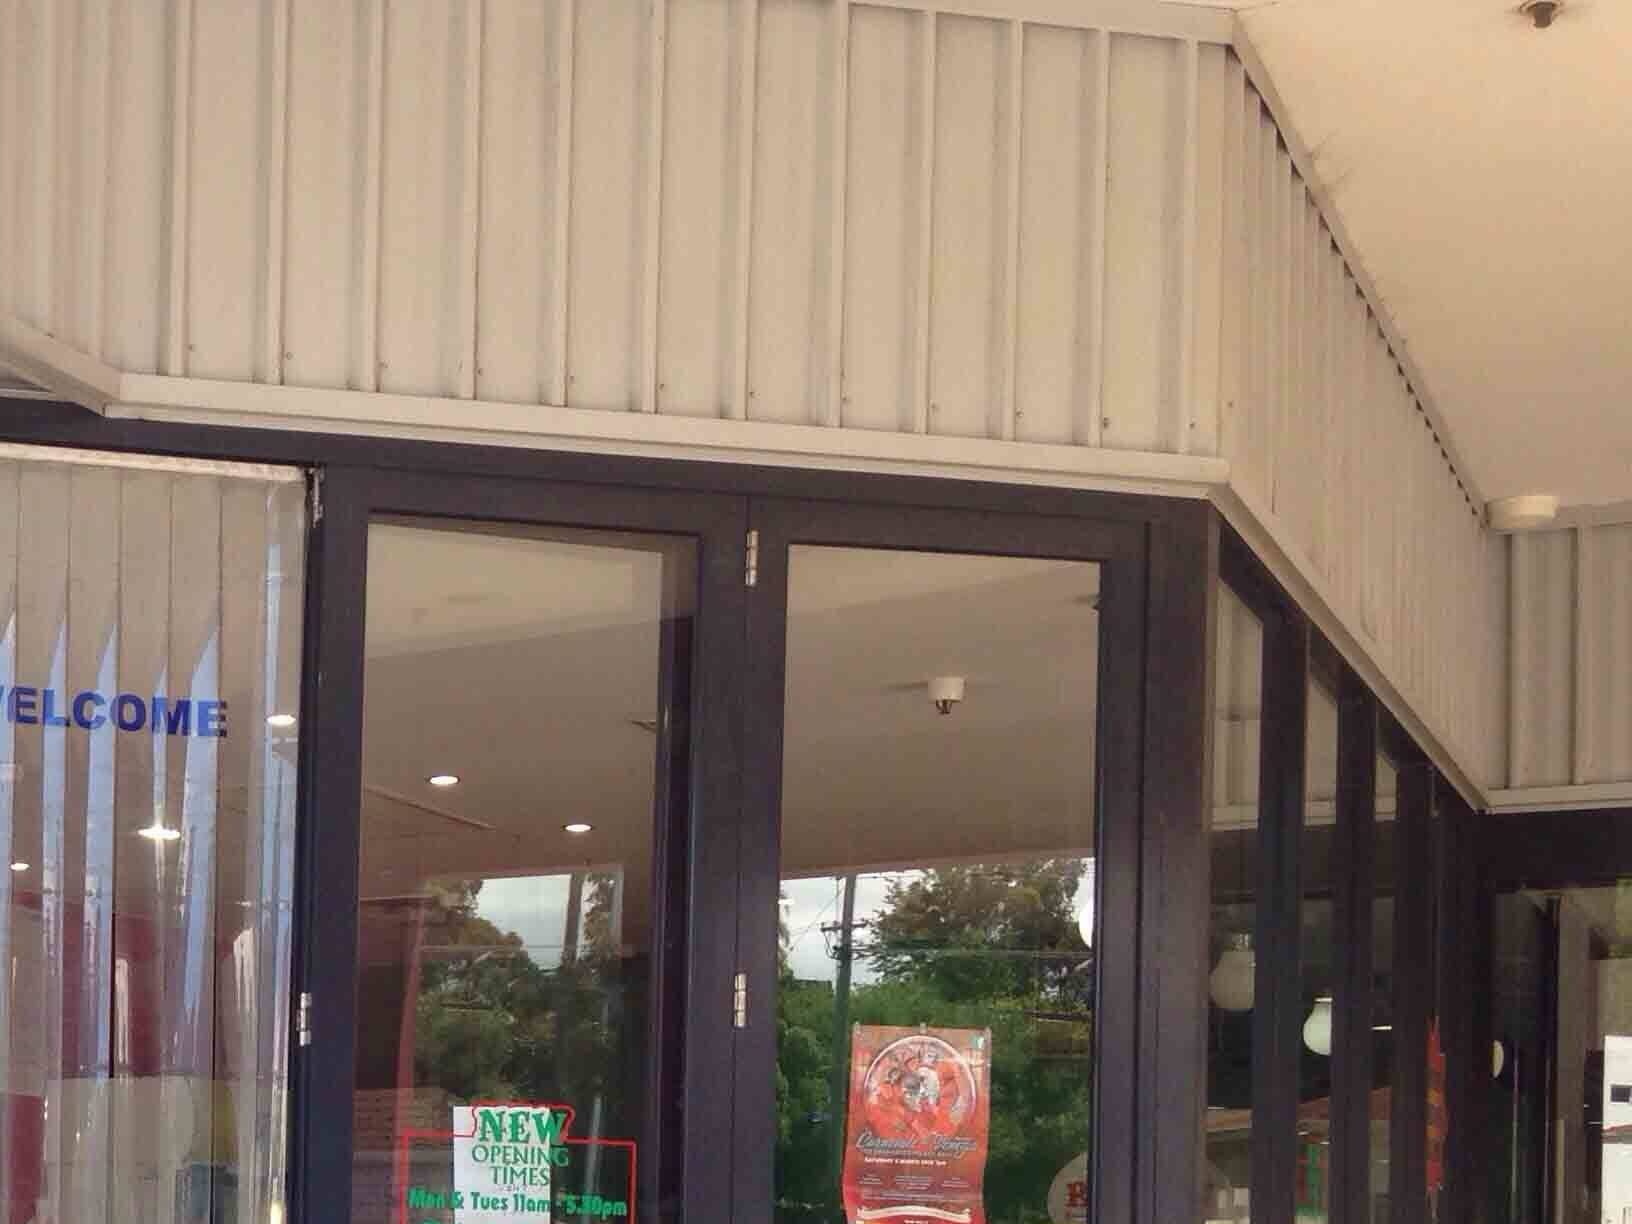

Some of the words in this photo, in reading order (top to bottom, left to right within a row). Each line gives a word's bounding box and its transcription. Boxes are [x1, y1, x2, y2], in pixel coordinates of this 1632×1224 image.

[479, 1108, 568, 1145] NEW
[471, 1144, 569, 1167] OPENING
[490, 1166, 550, 1186] TIMES
[471, 1191, 508, 1211] Tues
[513, 1191, 551, 1215] 11am
